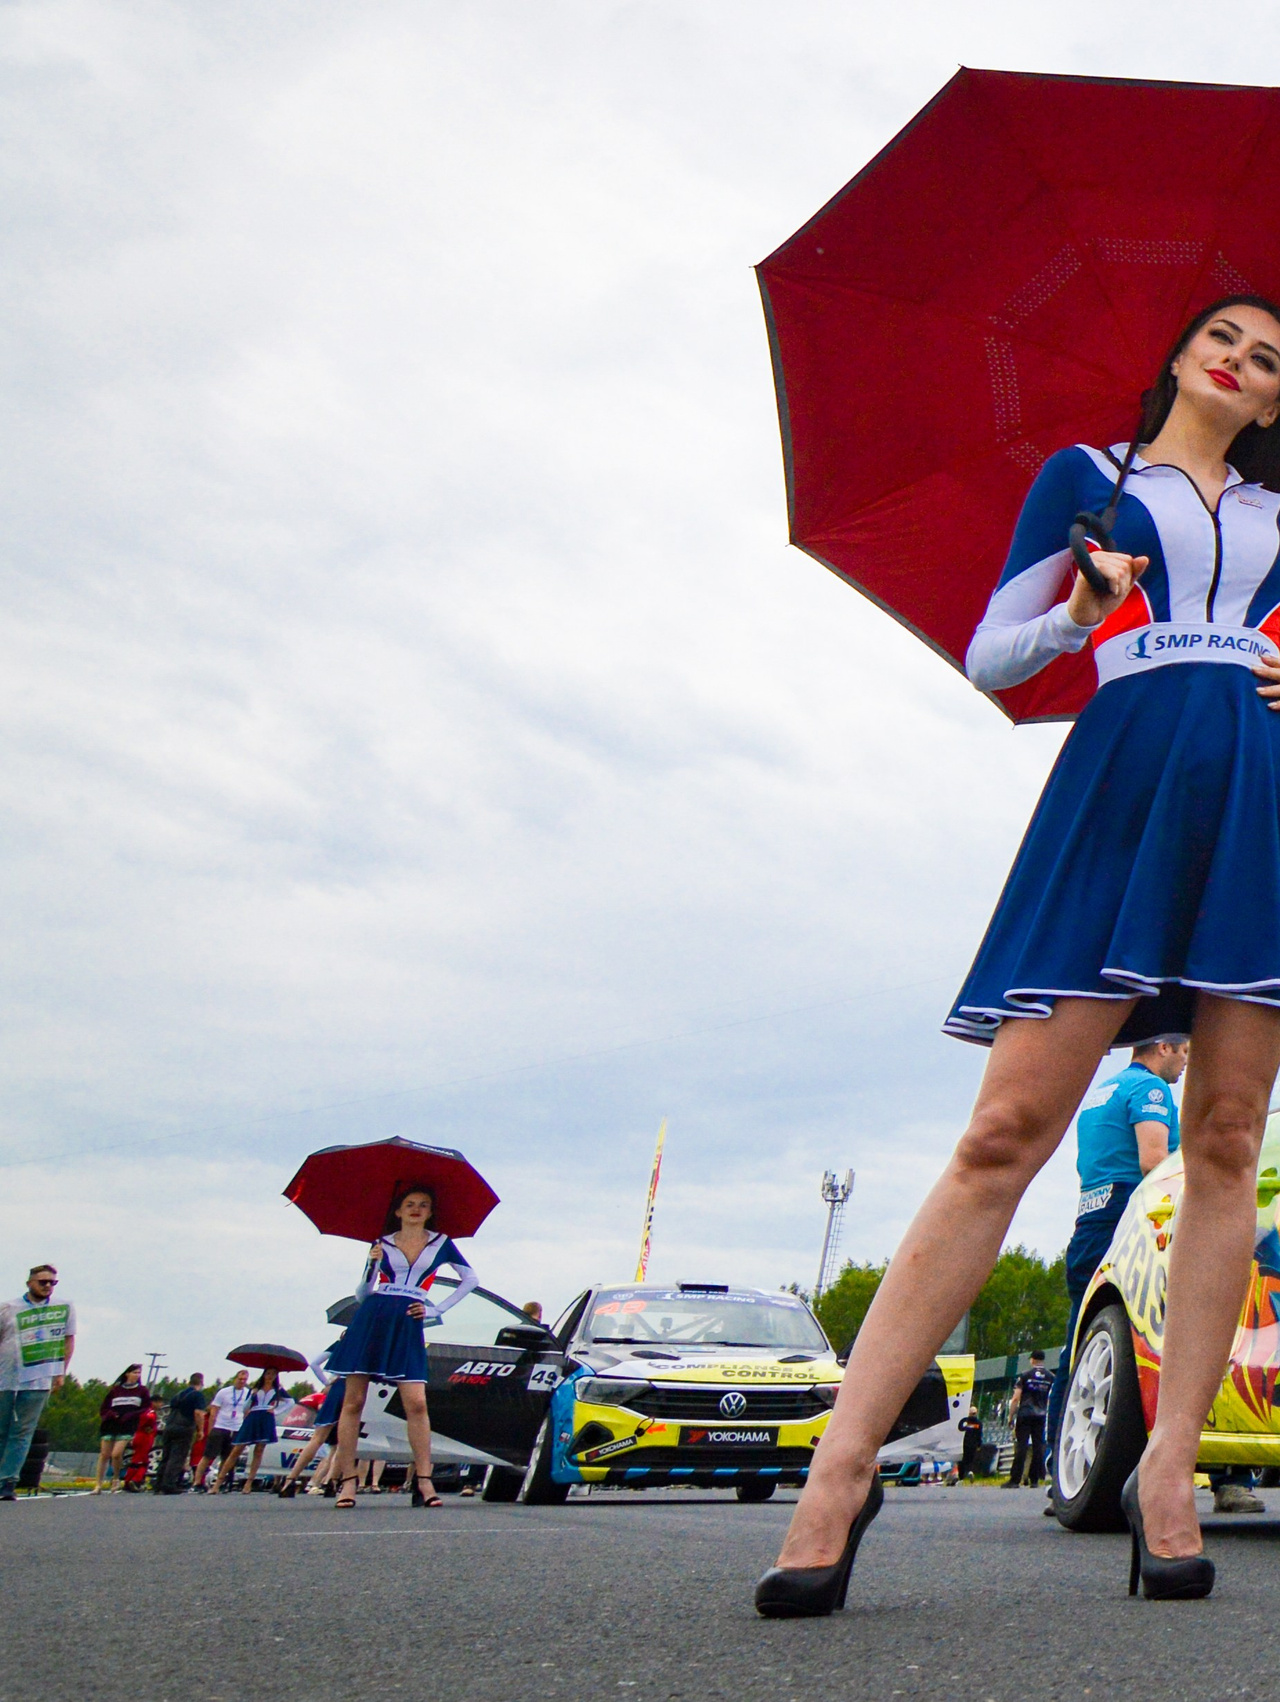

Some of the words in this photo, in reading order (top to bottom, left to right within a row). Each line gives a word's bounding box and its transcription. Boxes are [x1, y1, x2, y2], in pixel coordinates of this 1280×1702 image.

[1154, 634, 1203, 651] SMP
[707, 1294, 756, 1303] RACING
[454, 1361, 517, 1377] АВТО
[655, 1363, 794, 1372] COMPLIANCE
[721, 1369, 821, 1379] CONTROL
[532, 1370, 558, 1386] 49
[708, 1431, 770, 1442] YOKOHAMA
[598, 1439, 634, 1455] YOKOHAMA
